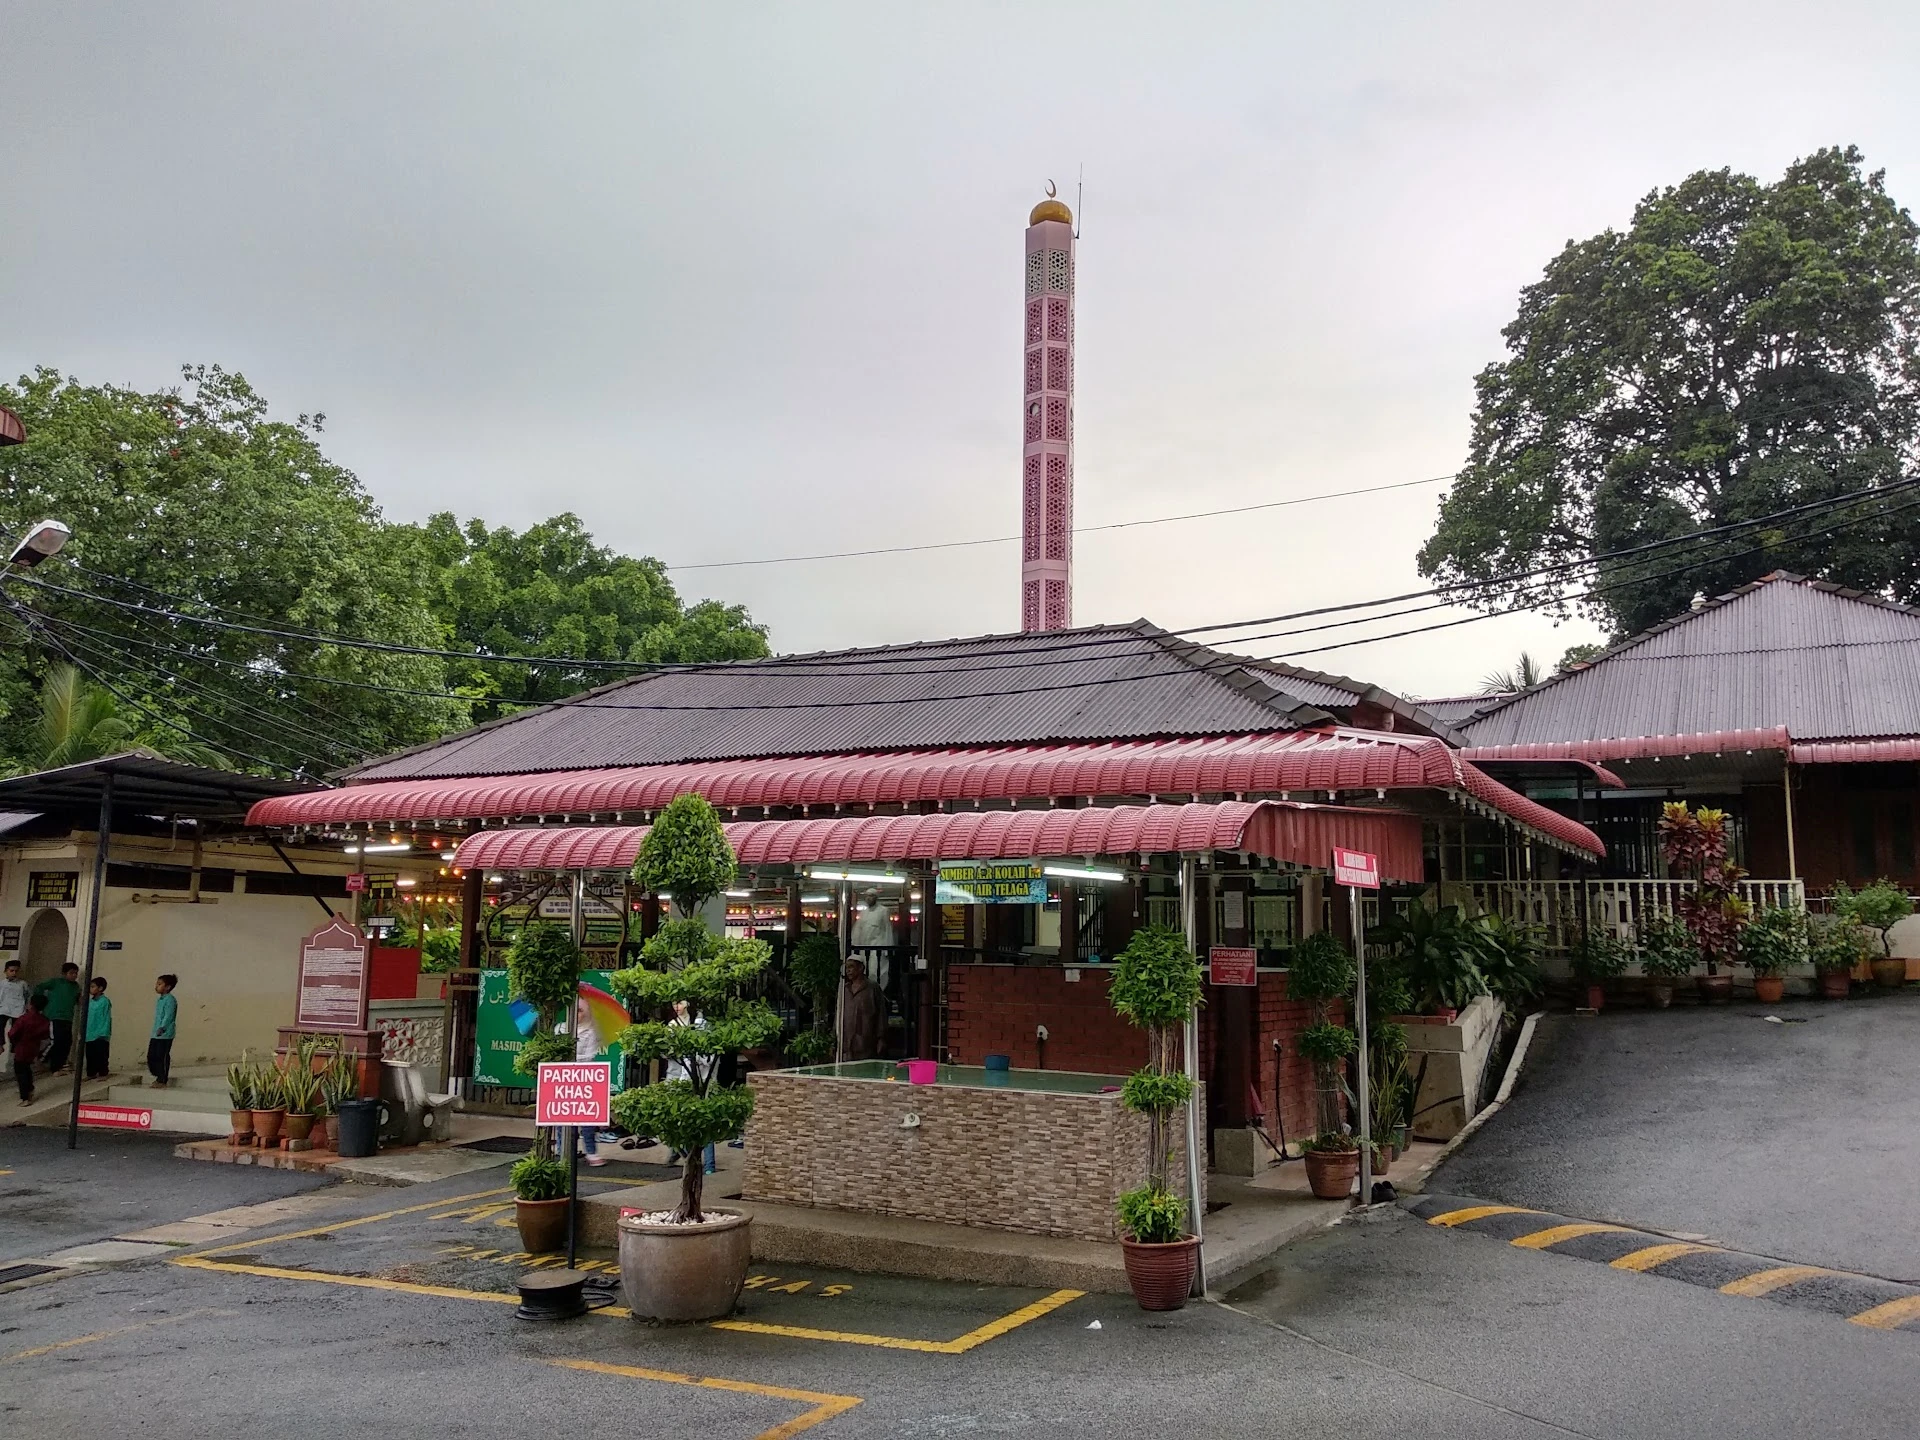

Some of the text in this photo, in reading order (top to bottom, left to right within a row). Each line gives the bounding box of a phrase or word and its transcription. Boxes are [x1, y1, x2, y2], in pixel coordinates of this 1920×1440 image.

[940, 867, 974, 881] SUMBER
[976, 866, 993, 880] AR
[995, 865, 1024, 879] KOLAH
[976, 883, 992, 896] AIR
[995, 882, 1029, 896] TELAGA
[1212, 950, 1253, 958] PERHATIAN!
[491, 1040, 522, 1052] MASJID
[543, 1068, 605, 1083] PARKING
[554, 1084, 593, 1099] KHAS
[546, 1101, 600, 1119] (USTAZ)
[743, 1275, 854, 1297] HAS
